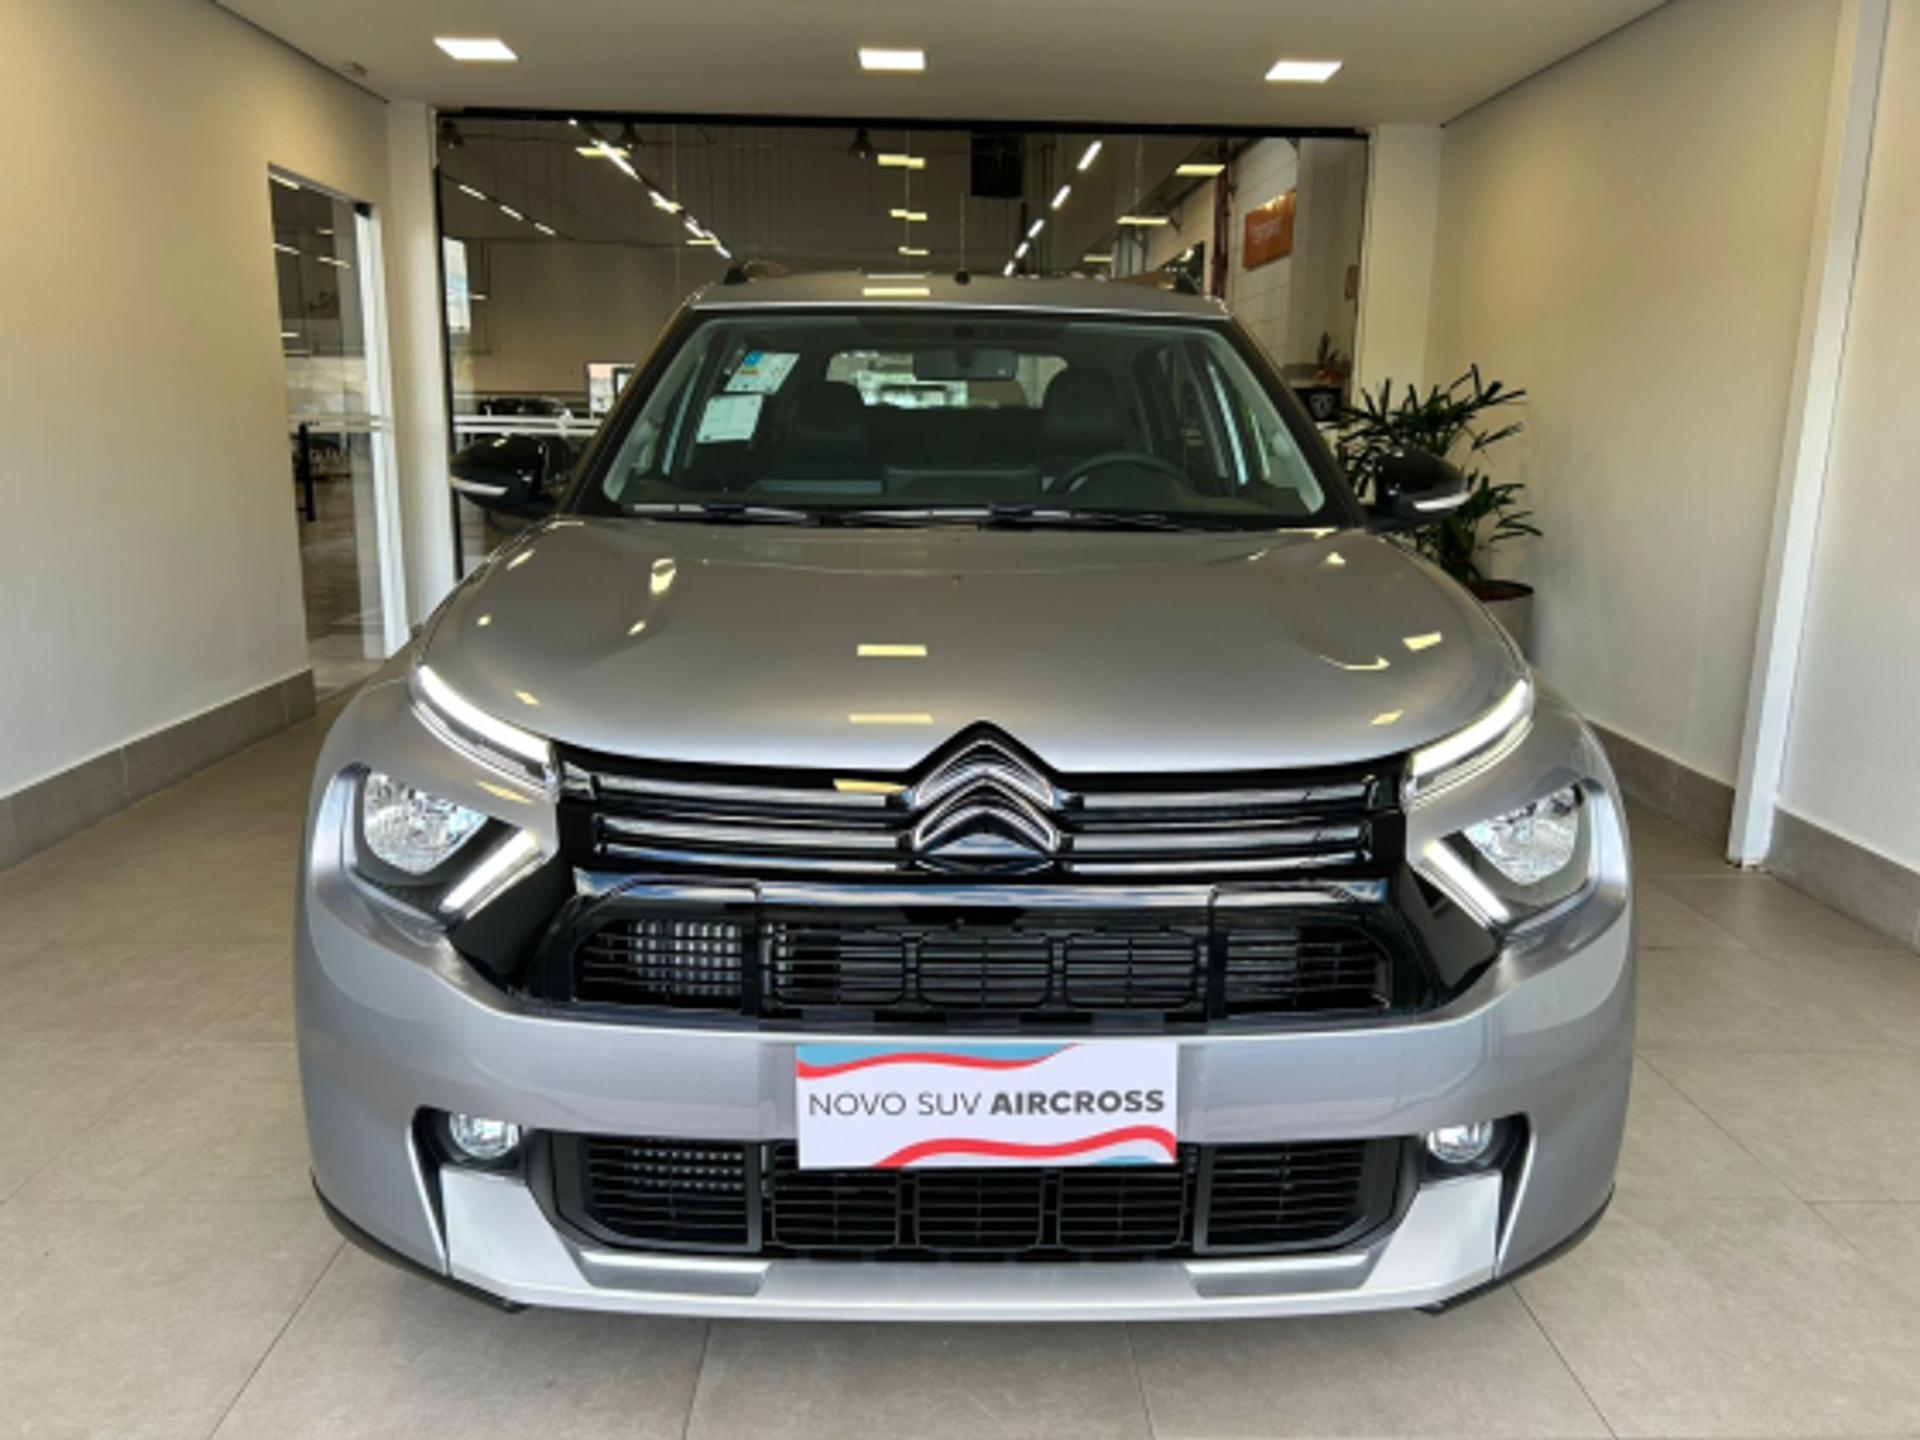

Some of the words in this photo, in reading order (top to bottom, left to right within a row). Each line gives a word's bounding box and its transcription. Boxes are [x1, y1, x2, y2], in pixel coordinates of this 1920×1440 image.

[809, 1092, 907, 1116] NOVO
[917, 1092, 982, 1115] SUV
[990, 1089, 1165, 1115] AIRCROSS
